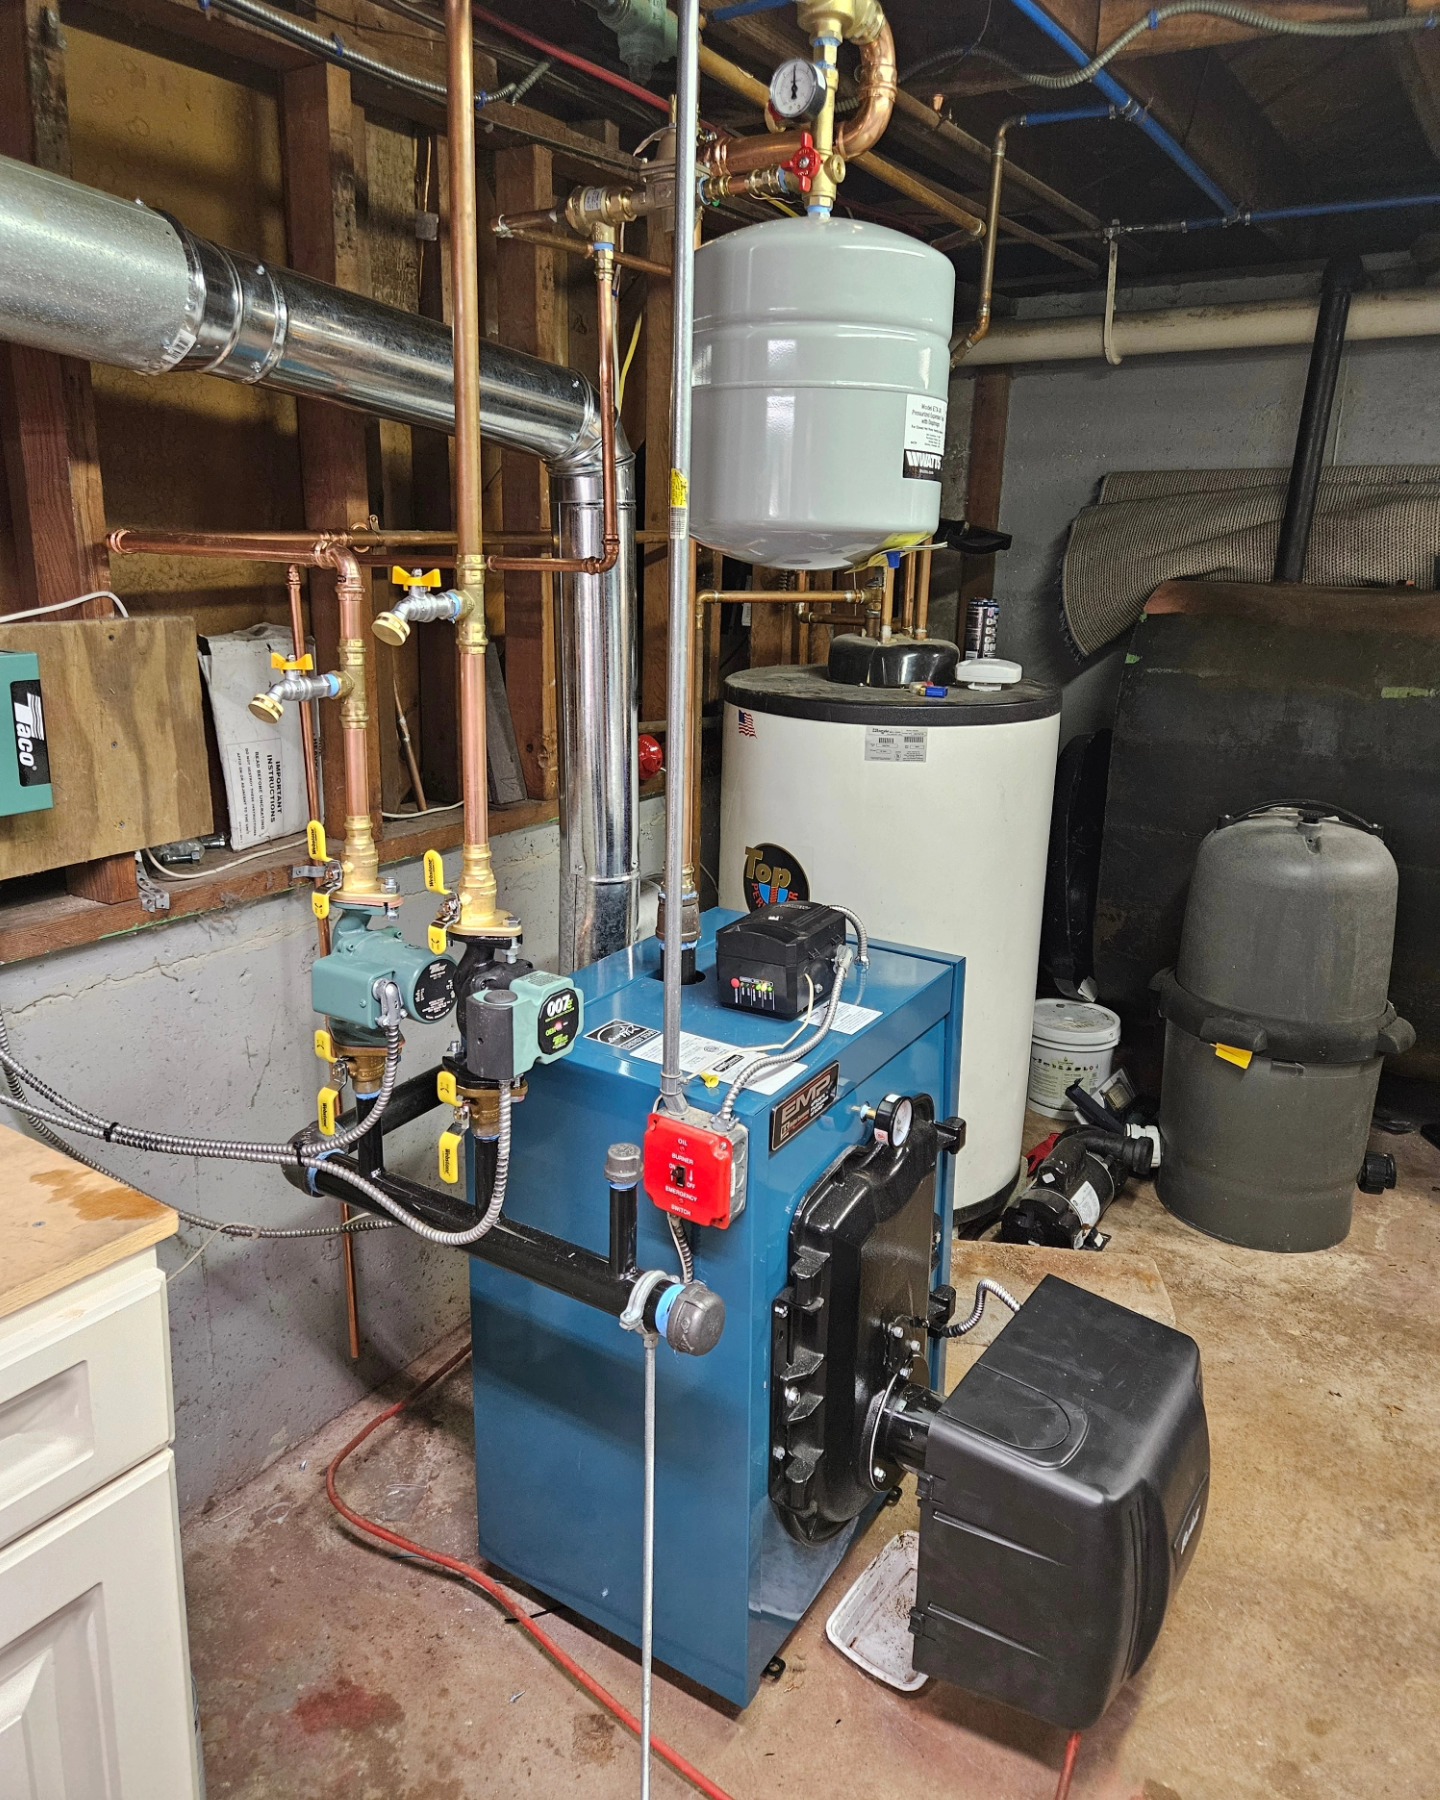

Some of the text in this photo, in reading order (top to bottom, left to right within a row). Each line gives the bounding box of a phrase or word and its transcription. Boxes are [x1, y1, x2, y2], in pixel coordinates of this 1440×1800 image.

[906, 450, 942, 470] WATTS
[14, 692, 44, 767] Taco
[267, 755, 275, 822] INSTRUCTIONS
[745, 846, 792, 888] Top
[782, 1074, 831, 1124] EMP
[678, 1138, 687, 1146] OIL
[672, 1152, 694, 1165] BURNER
[665, 1185, 698, 1202] EMERGENCY
[671, 1204, 691, 1216] SWITCH
